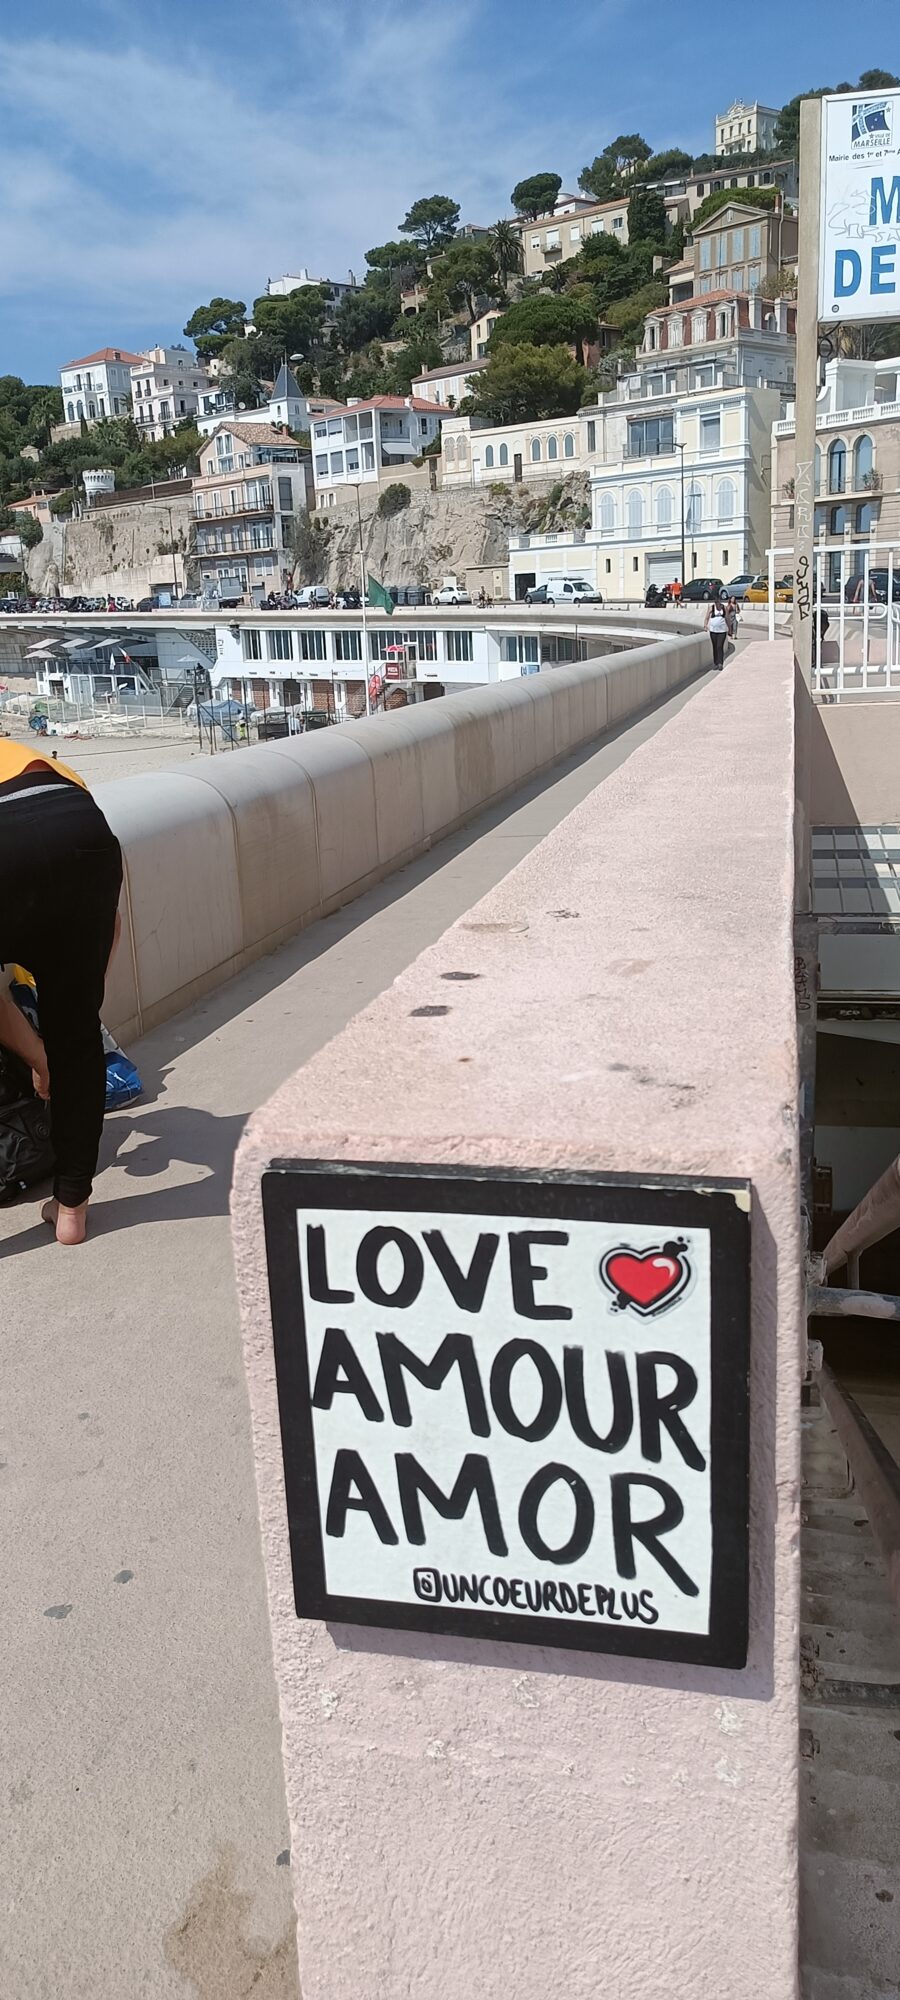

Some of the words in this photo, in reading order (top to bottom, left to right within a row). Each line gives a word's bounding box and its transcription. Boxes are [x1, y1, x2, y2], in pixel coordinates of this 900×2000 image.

[852, 152, 865, 160] des
[875, 150, 882, 158] et
[853, 138, 890, 148] MARSEILLE
[834, 244, 896, 298] DE
[306, 1223, 573, 1321] LOVE
[311, 1328, 706, 1472] AMOUR
[325, 1448, 700, 1598] AMOR
